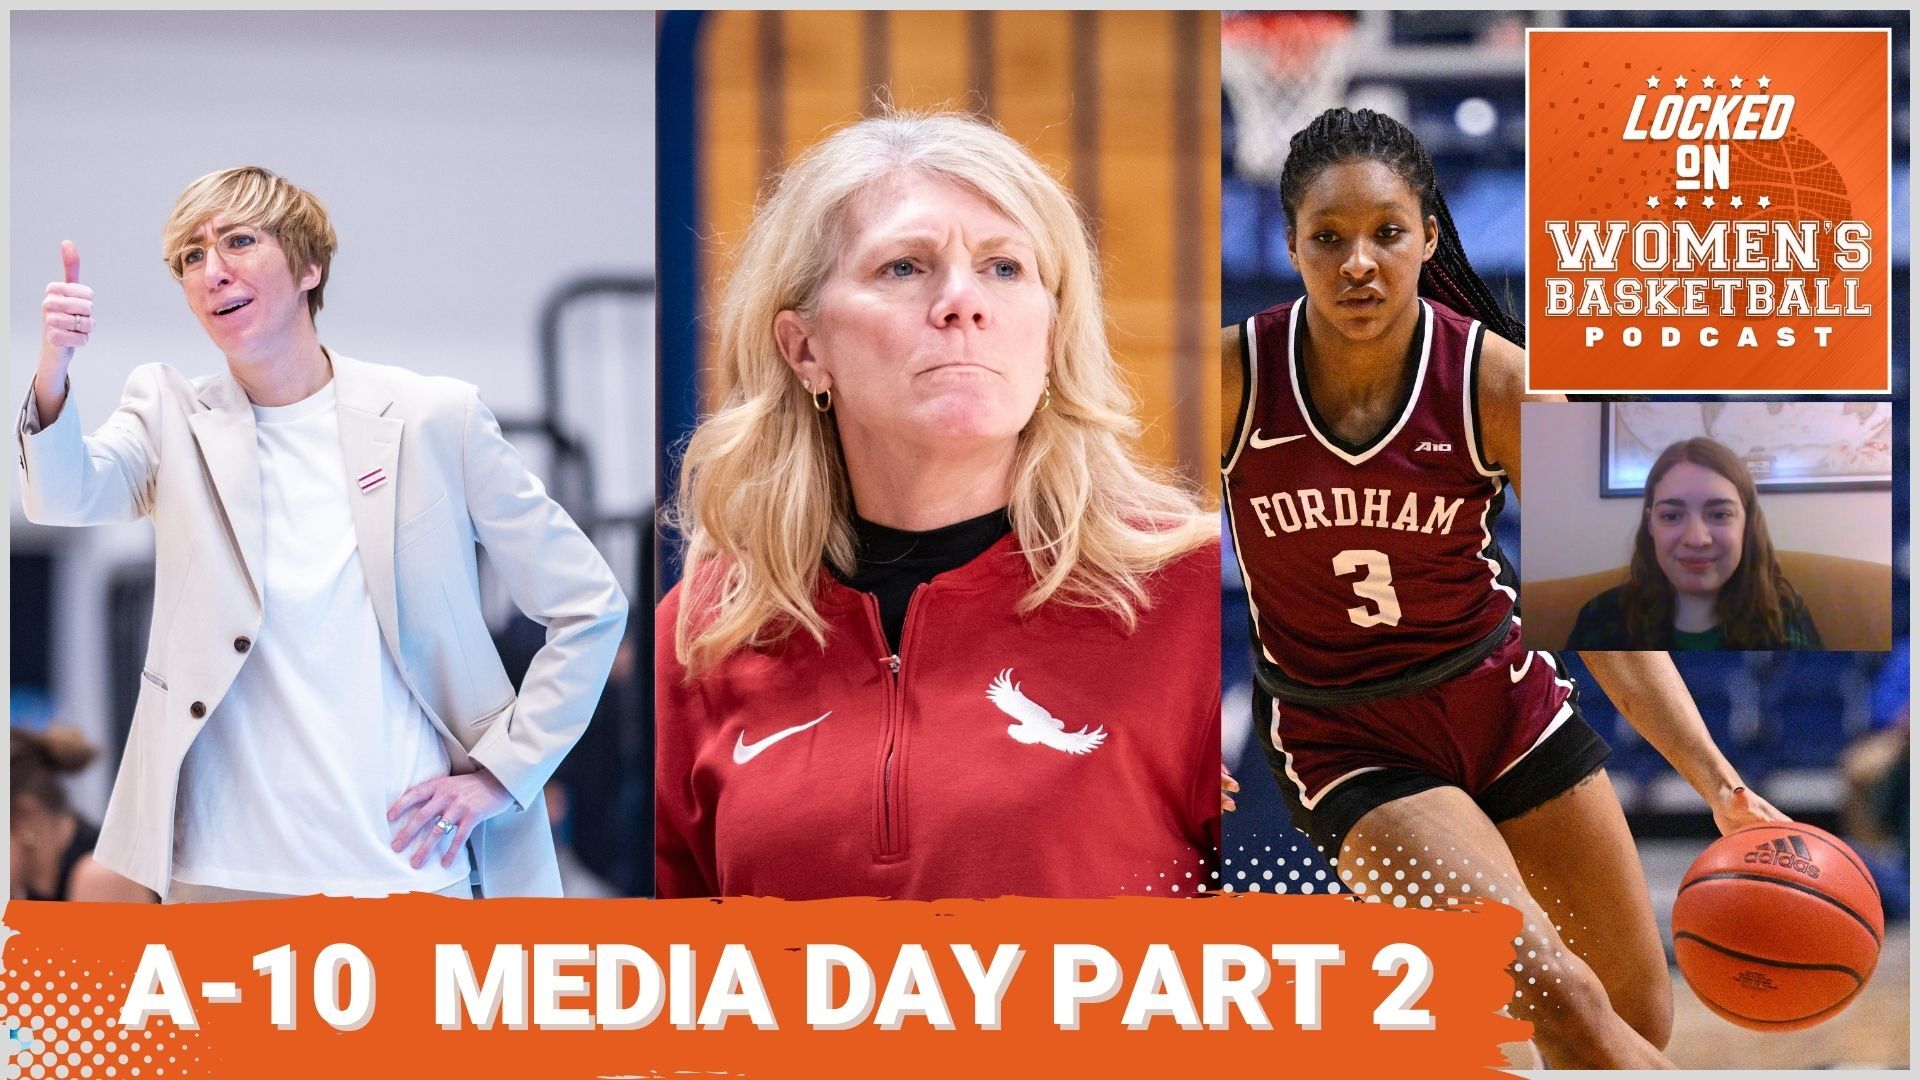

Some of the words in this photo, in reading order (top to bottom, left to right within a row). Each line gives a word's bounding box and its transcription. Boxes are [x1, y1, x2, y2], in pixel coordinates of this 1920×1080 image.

[1250, 487, 1465, 538] FORDHAM
[1332, 549, 1402, 628] 3
[1744, 850, 1820, 878] adidas
